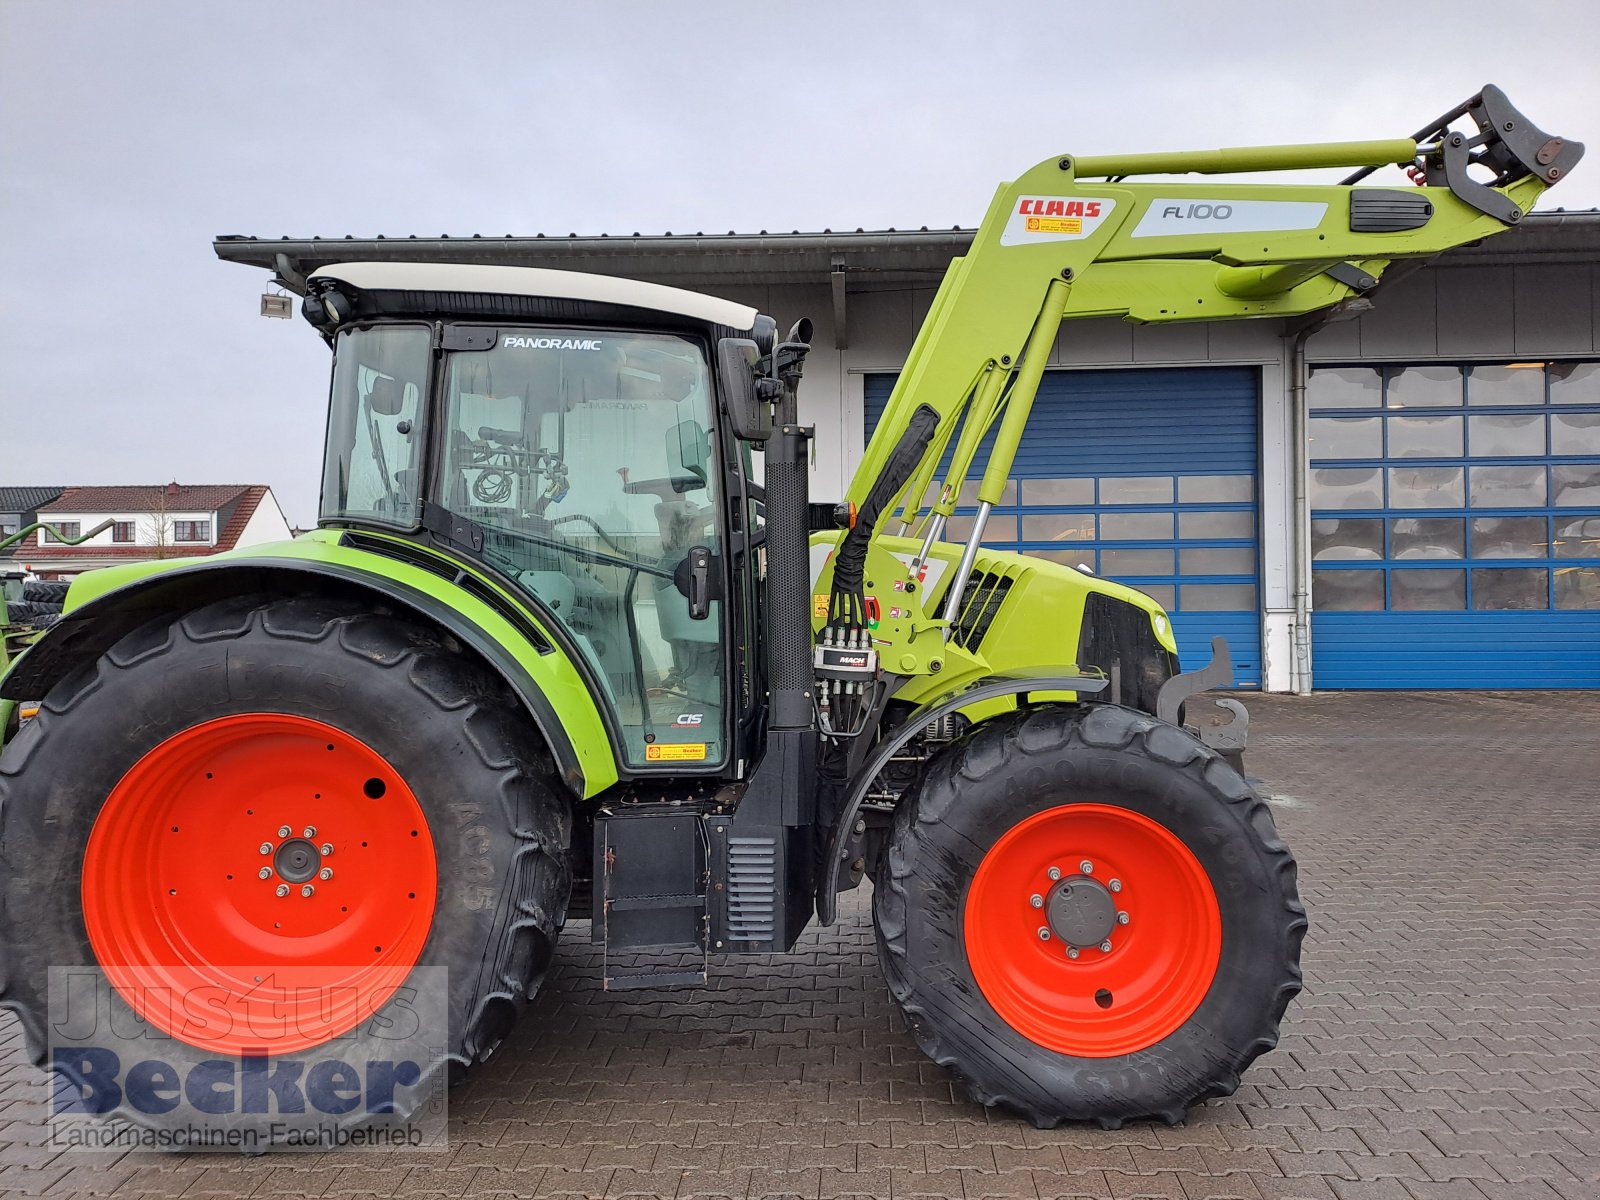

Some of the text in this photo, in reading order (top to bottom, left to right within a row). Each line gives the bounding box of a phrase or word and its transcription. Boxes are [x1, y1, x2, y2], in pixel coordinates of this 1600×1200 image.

[1018, 199, 1102, 218] CLAAS
[503, 337, 603, 351] PANORAMIC
[839, 656, 865, 664] MACH
[676, 713, 703, 724] CIS
